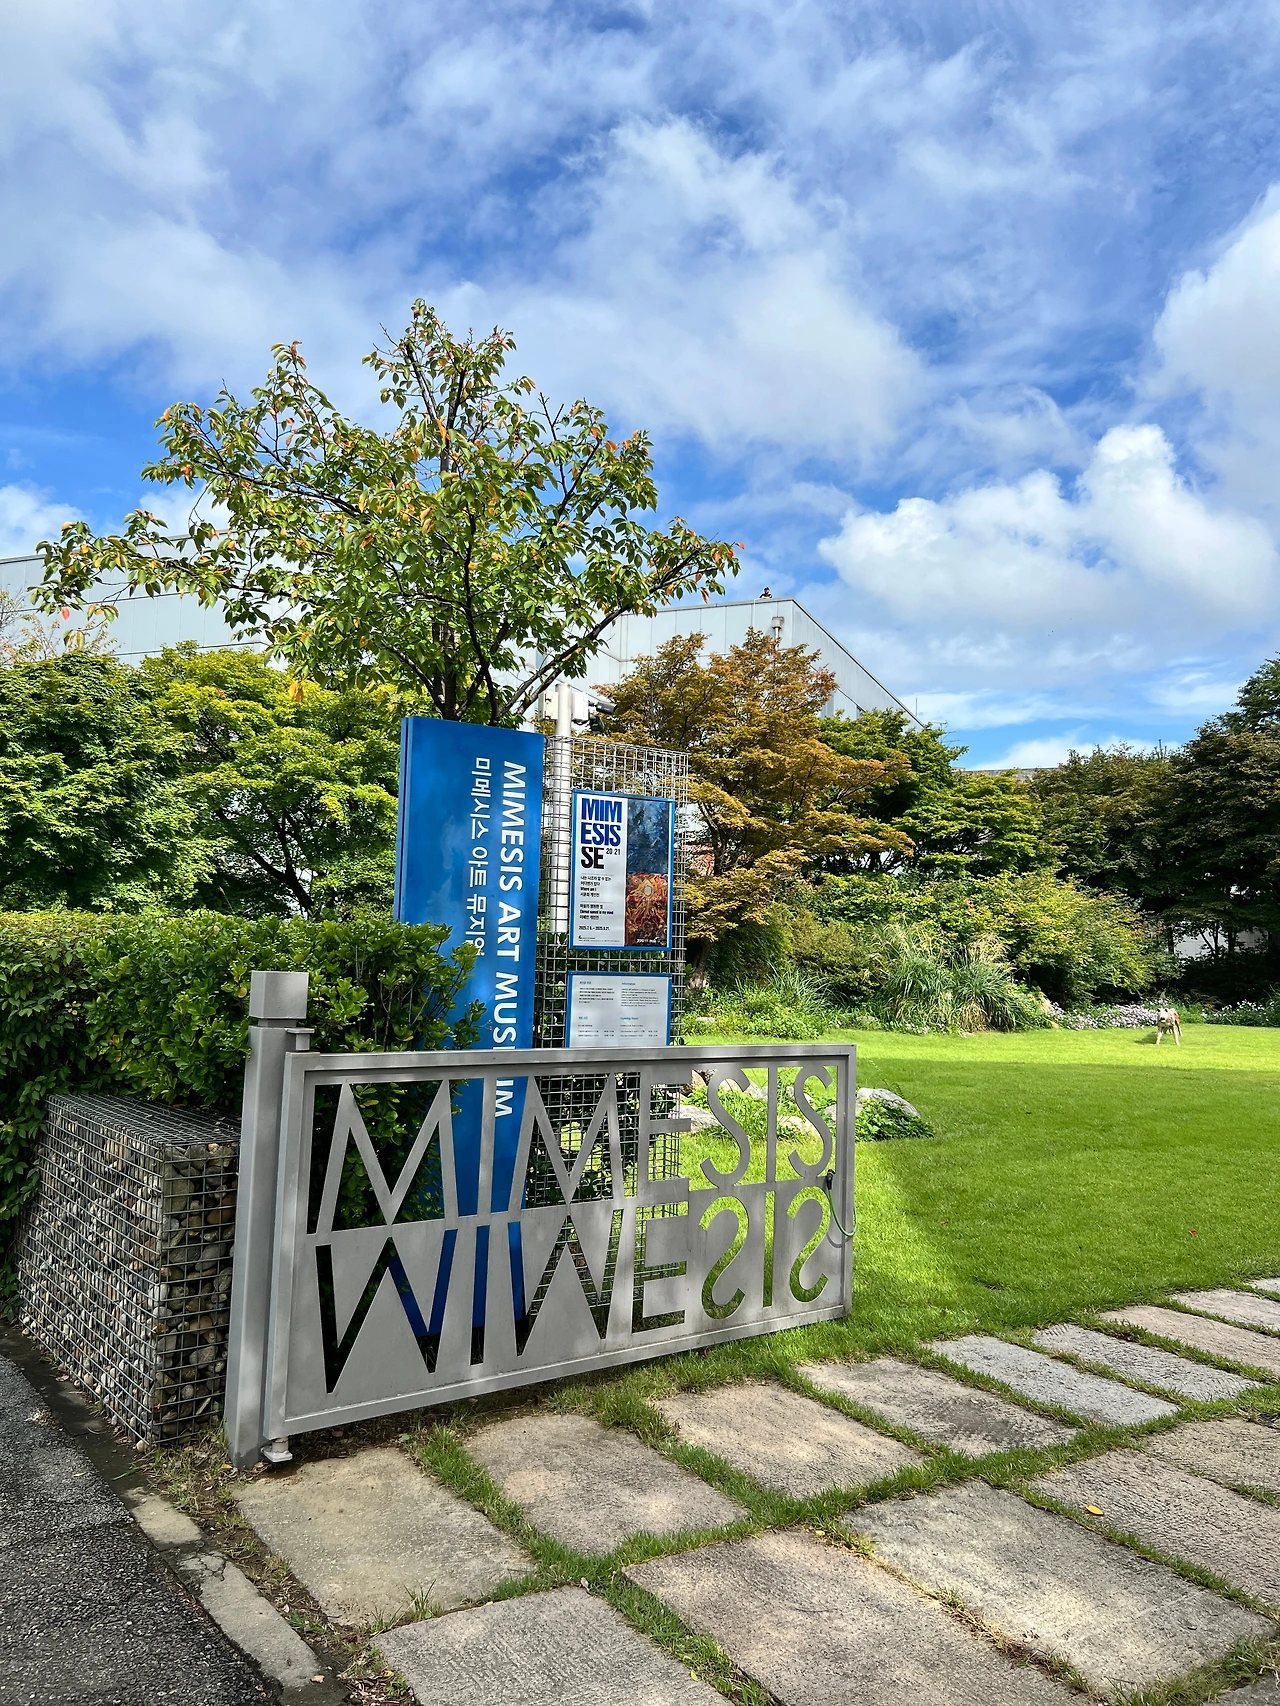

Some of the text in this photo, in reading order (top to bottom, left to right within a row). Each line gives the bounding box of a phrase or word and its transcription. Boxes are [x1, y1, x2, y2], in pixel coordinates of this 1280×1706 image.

[470, 757, 492, 840] 미메시스
[581, 797, 622, 823] MIM
[580, 821, 621, 847] ESIS
[468, 846, 489, 888] 아트
[580, 846, 605, 869] SE
[493, 760, 527, 1118] MIMESIS ART MUSM
[314, 1064, 833, 1235] MIMESIS
